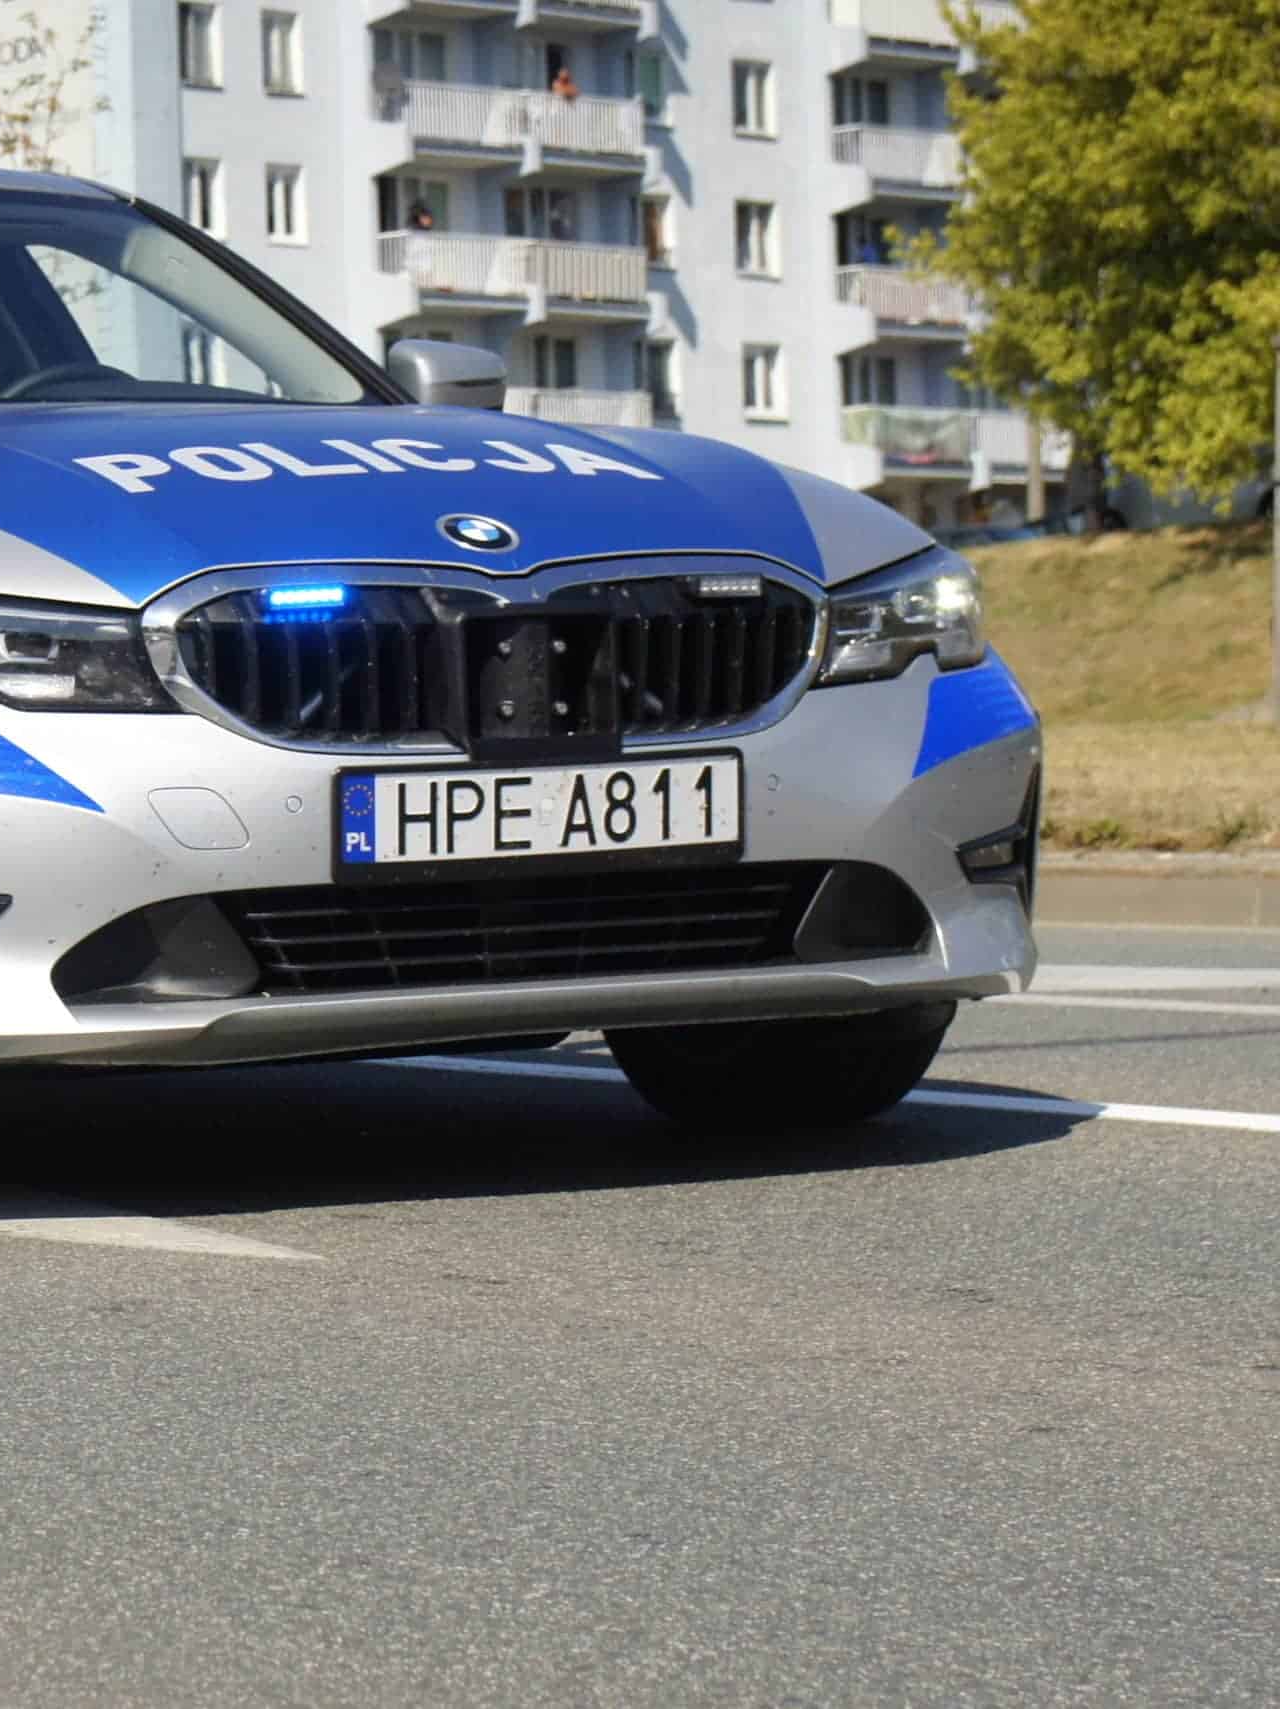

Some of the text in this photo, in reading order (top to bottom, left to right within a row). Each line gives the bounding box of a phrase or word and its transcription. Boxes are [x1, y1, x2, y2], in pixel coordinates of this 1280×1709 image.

[74, 439, 664, 493] POLICJA
[398, 765, 713, 856] HPE A811
[345, 831, 372, 853] PL
